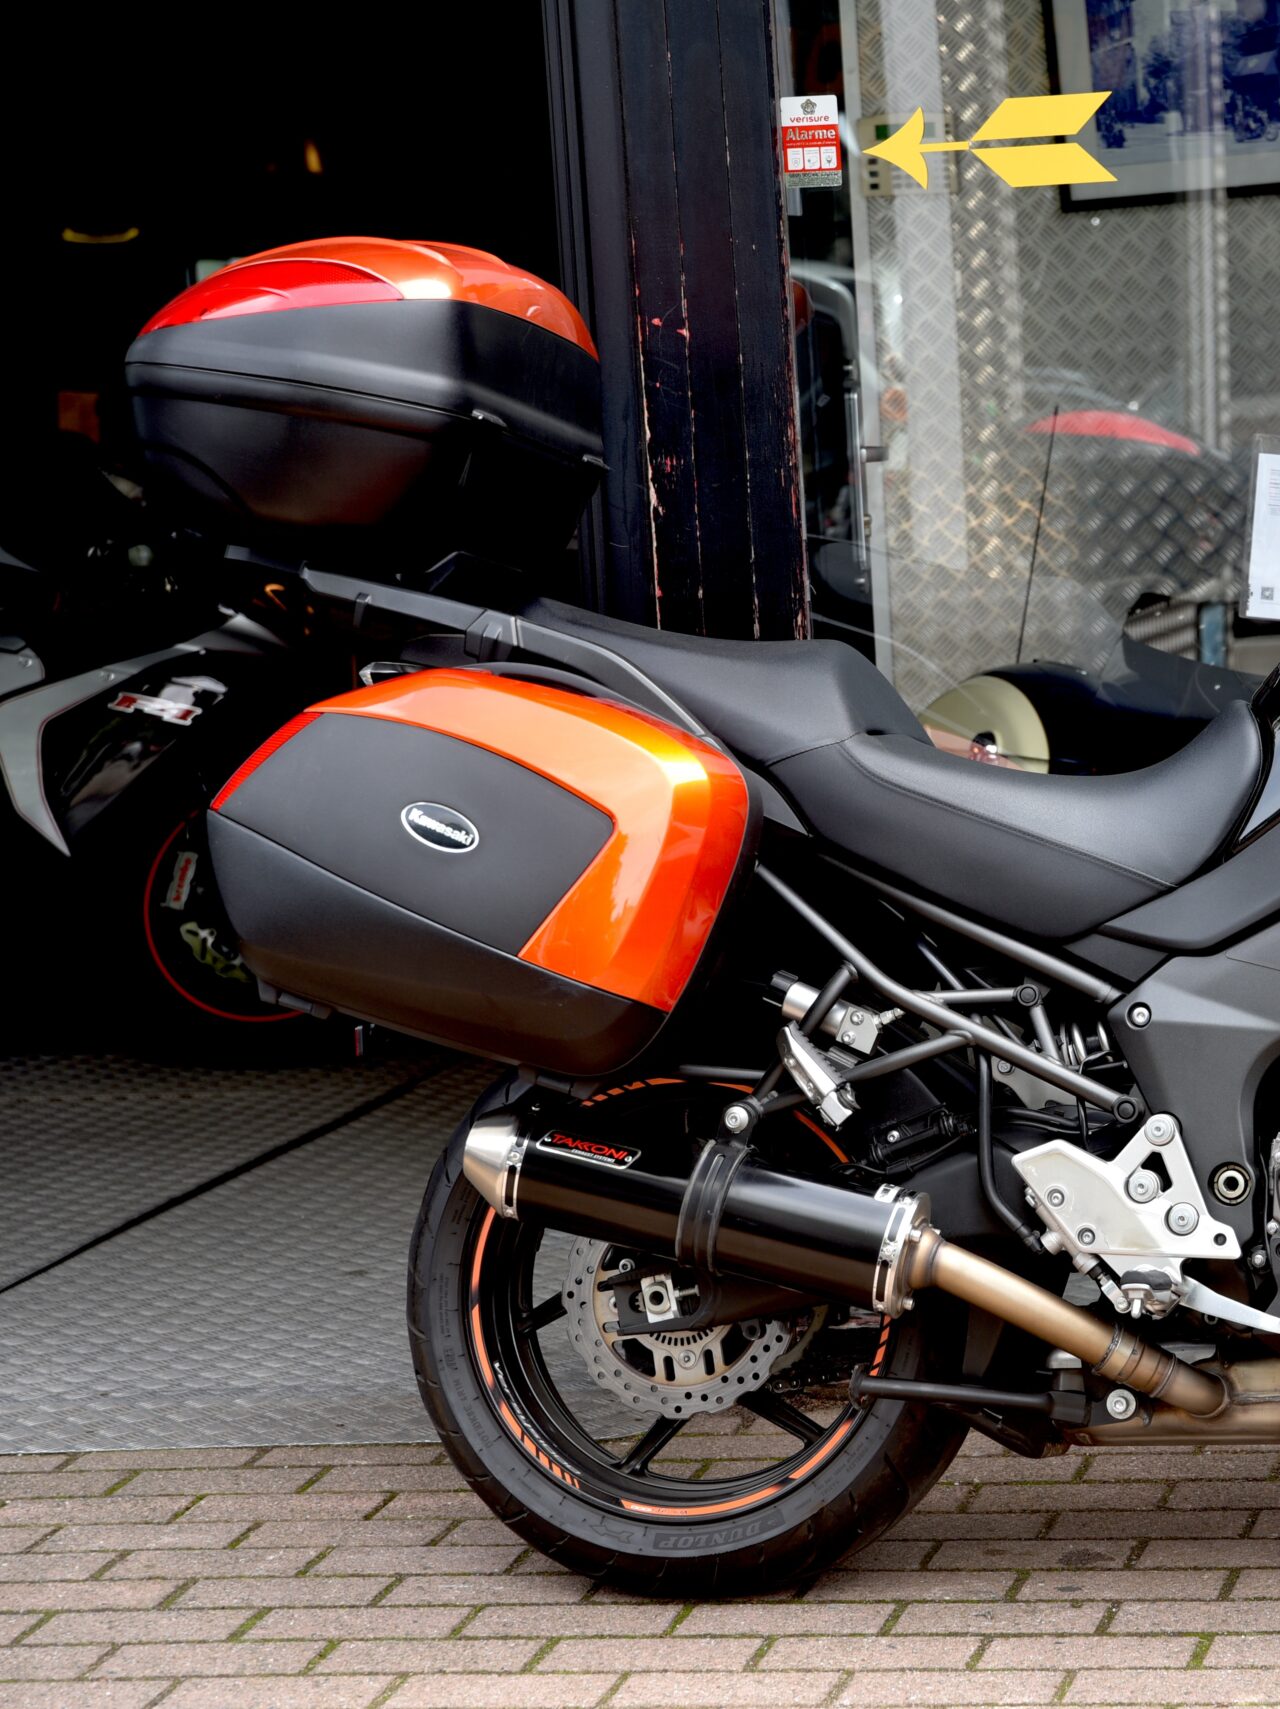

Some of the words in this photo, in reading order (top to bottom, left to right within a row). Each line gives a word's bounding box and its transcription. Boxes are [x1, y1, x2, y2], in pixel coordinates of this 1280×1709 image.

[790, 115, 830, 123] verisure
[786, 127, 836, 140] Alarme
[658, 1518, 765, 1549] DUNLOP
